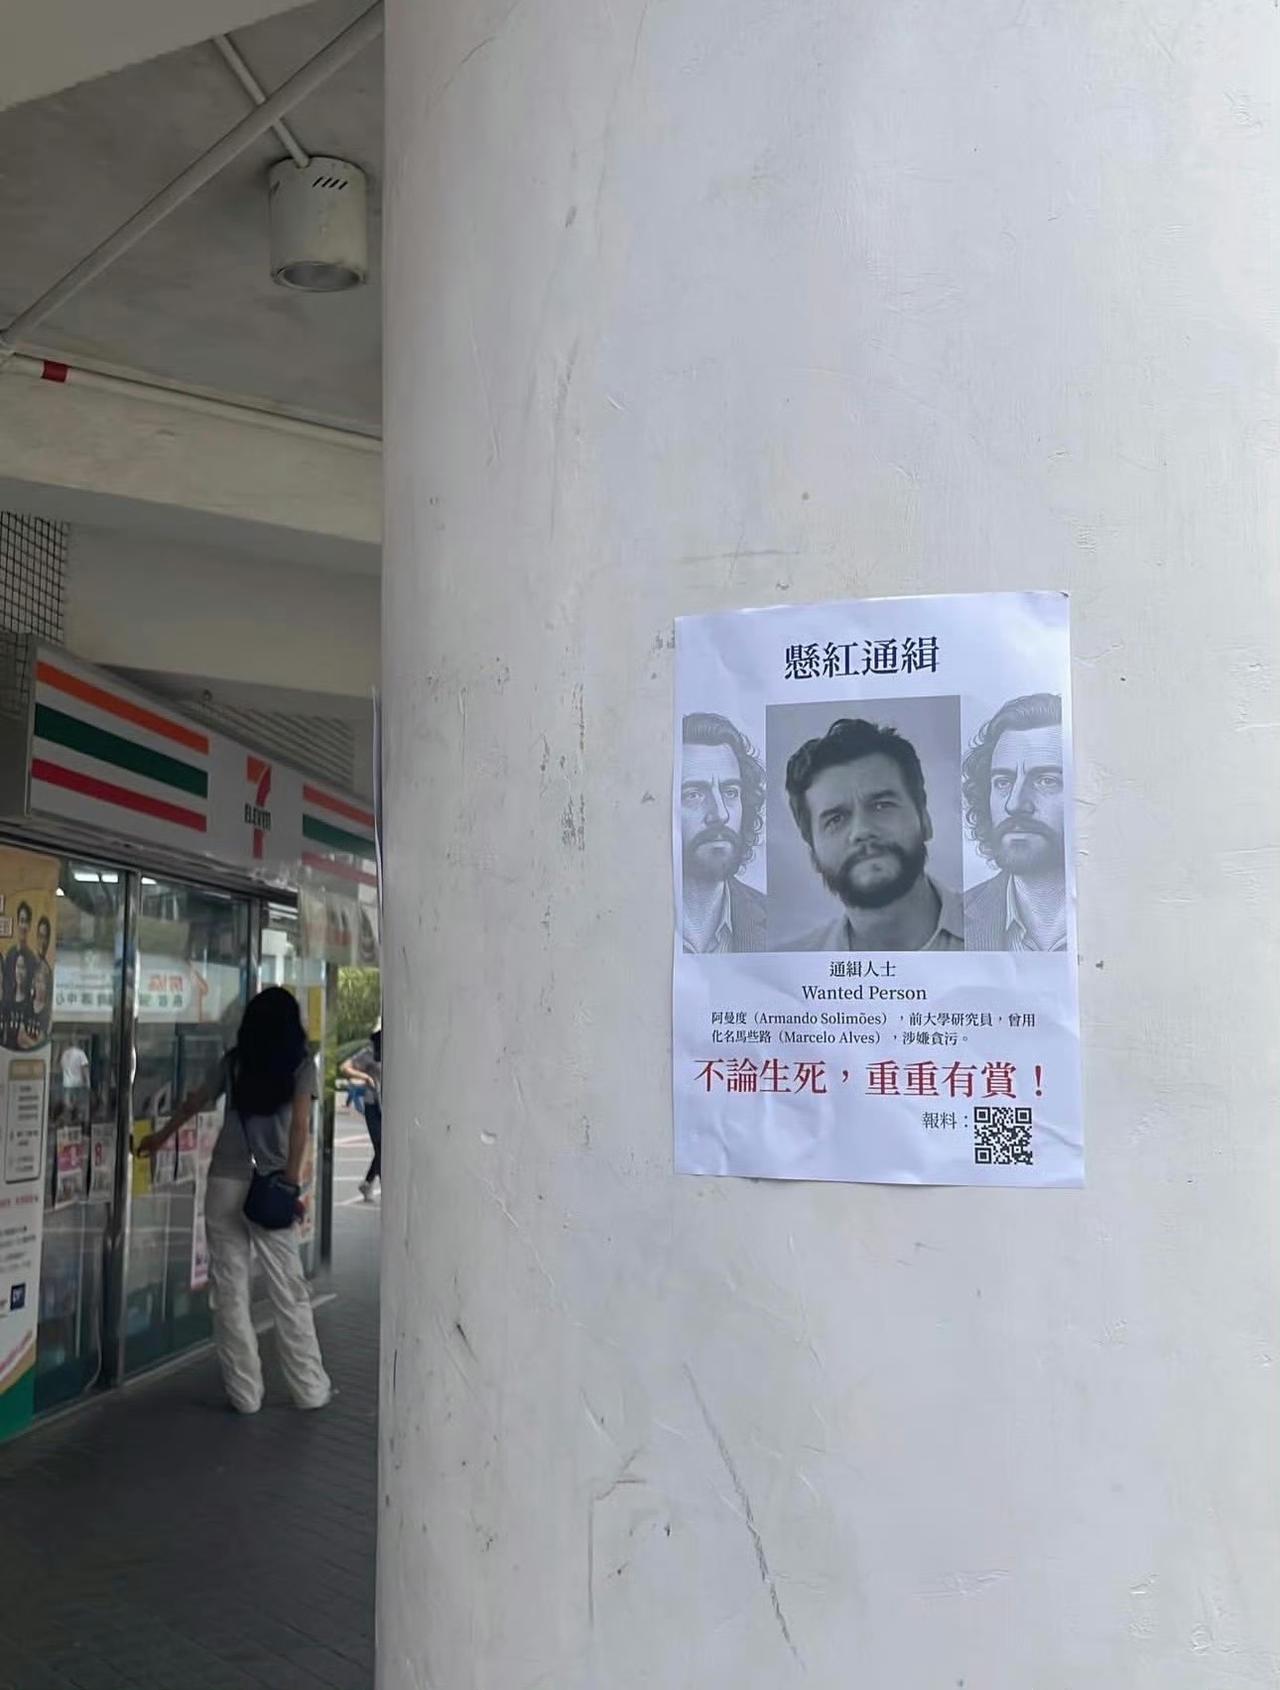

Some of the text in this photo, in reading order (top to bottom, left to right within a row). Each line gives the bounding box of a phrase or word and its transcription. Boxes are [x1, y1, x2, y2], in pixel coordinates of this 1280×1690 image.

[784, 636, 940, 680] 懸紅通緝
[246, 756, 272, 860] 7
[829, 960, 897, 978] 通緝人士
[802, 985, 927, 1000] Wanted Person
